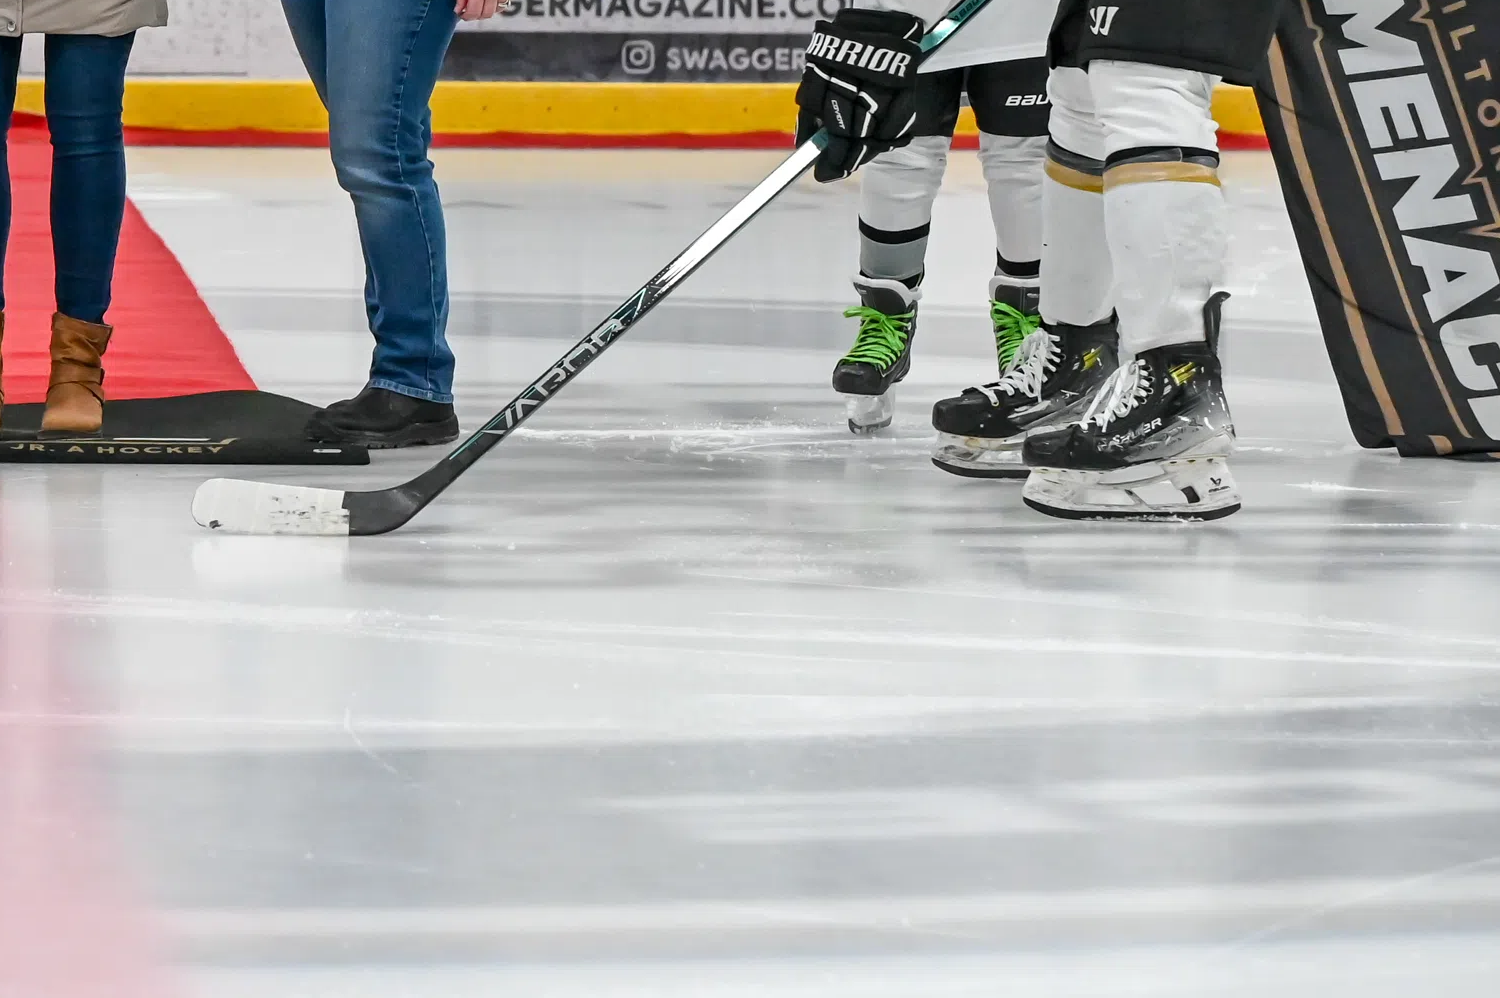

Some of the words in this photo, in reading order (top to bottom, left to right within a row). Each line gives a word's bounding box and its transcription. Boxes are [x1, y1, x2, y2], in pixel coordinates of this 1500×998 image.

[806, 31, 912, 78] ARRIOR
[66, 444, 85, 454] A
[97, 445, 224, 455] HOCKEY
